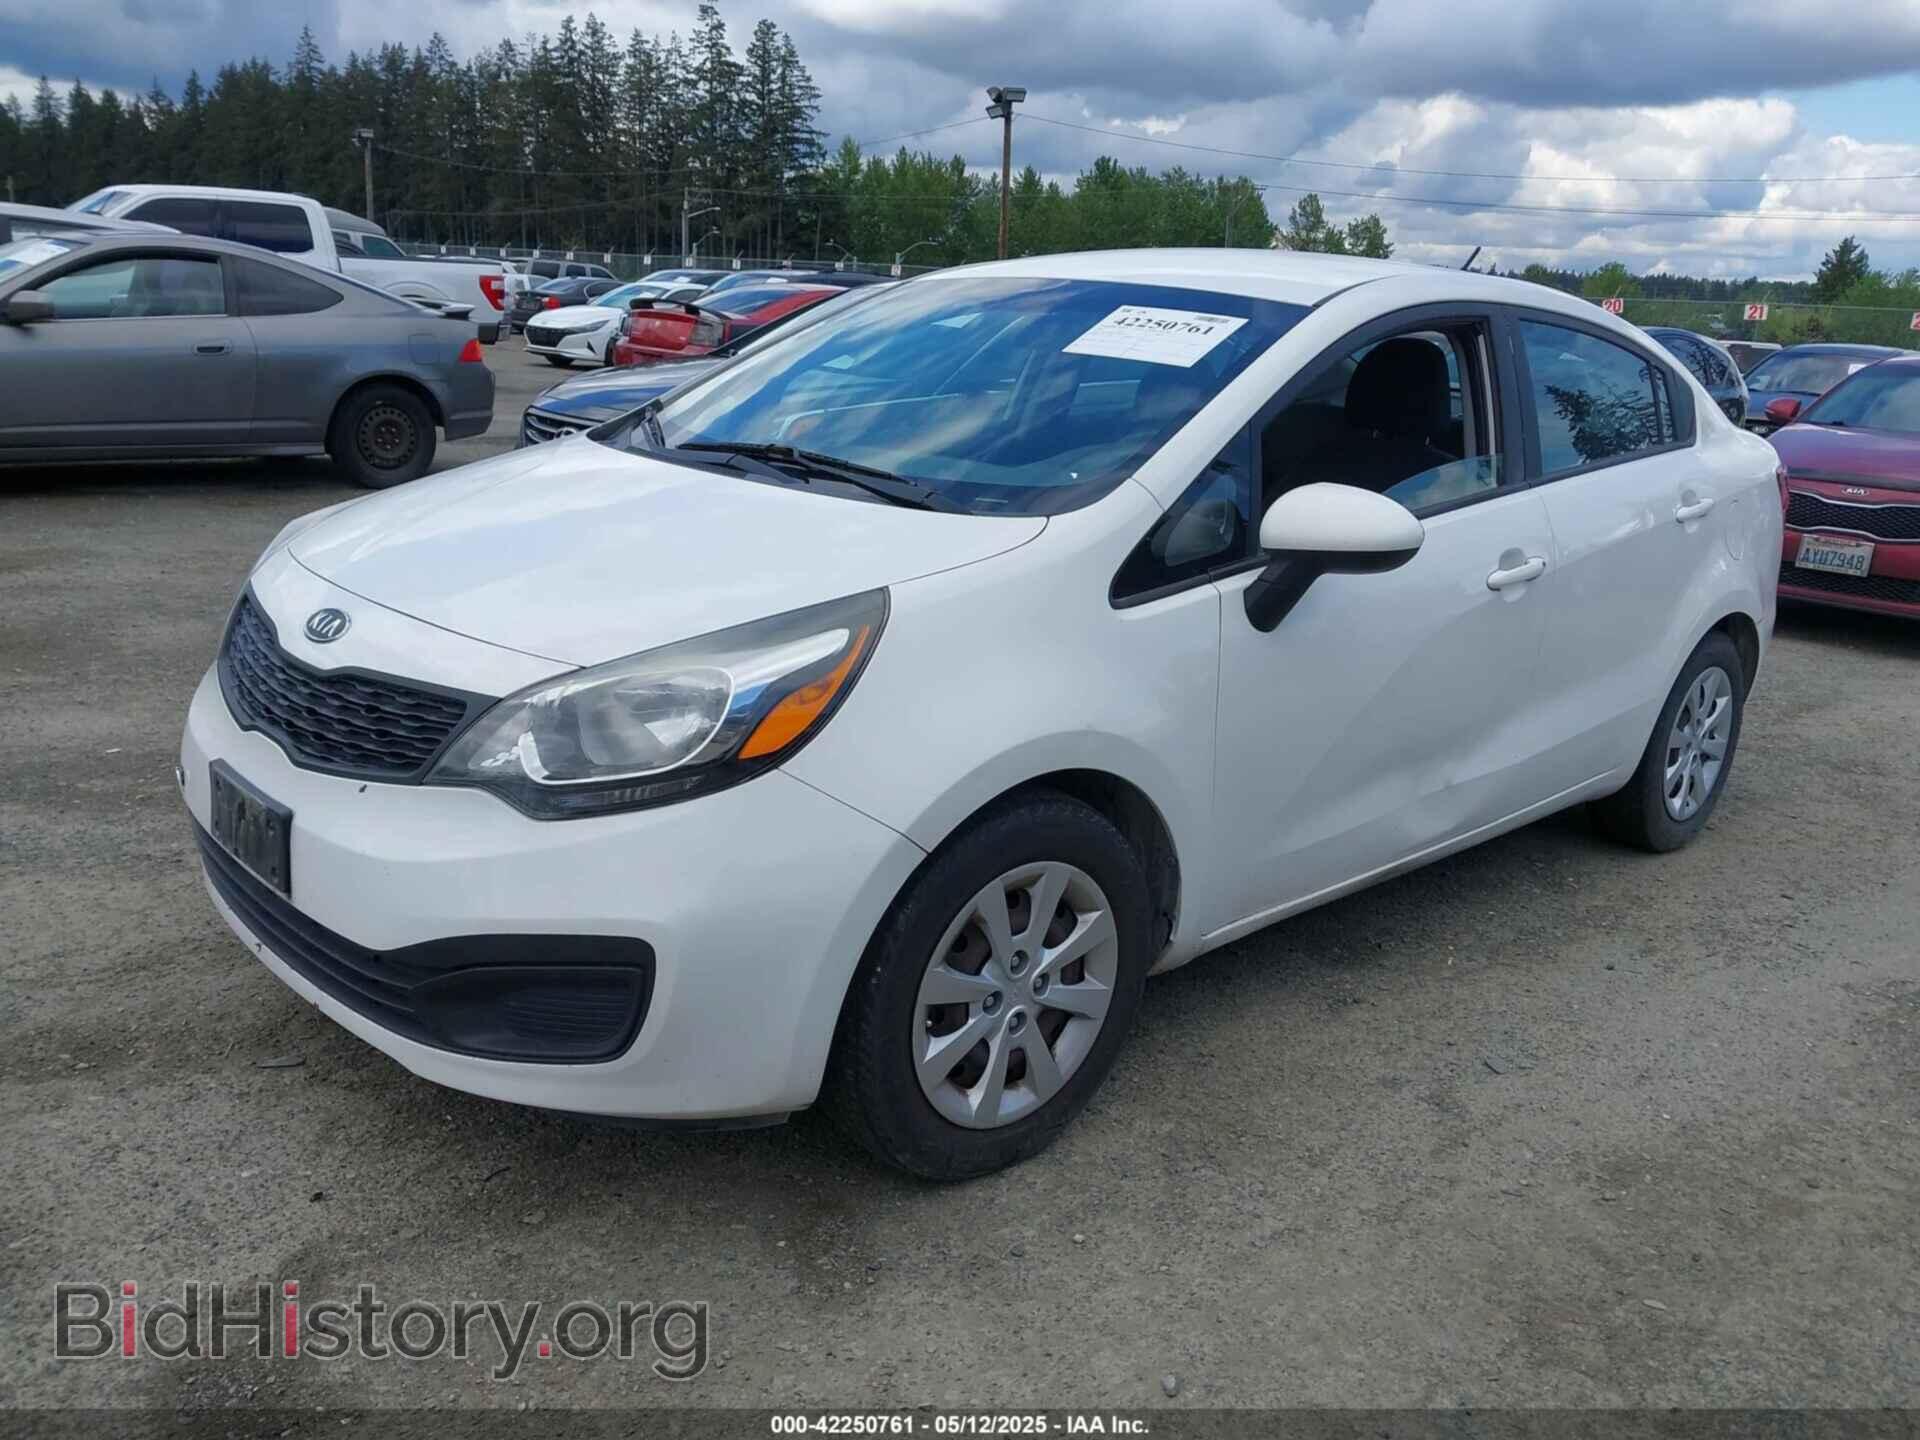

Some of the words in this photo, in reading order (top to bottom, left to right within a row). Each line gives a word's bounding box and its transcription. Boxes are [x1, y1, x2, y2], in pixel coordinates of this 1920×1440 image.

[1604, 299, 1622, 313] 20
[1748, 304, 1765, 320] 21
[1114, 316, 1215, 336] 42250761
[308, 612, 341, 637] KIA
